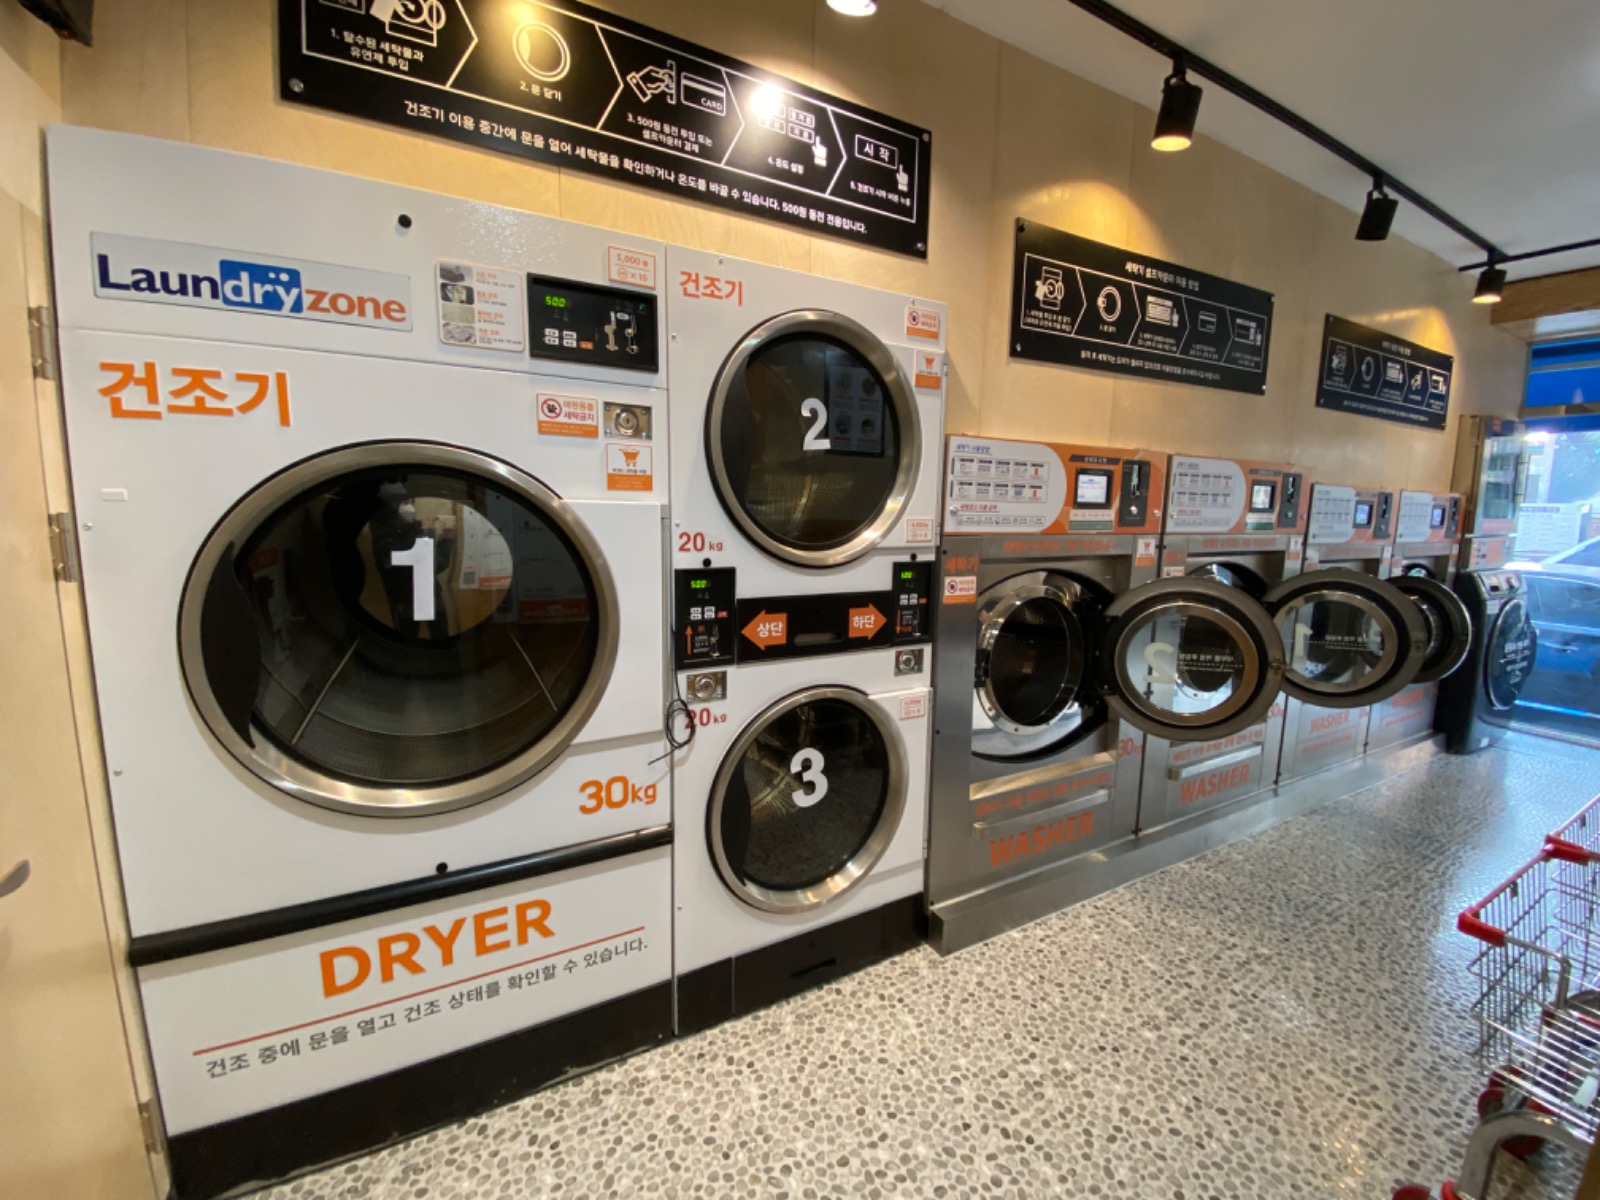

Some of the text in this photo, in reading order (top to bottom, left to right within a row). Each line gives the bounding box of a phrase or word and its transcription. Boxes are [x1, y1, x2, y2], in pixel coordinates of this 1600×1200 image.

[701, 98, 723, 110] CARD
[404, 100, 868, 234] 건조기 이용 중간에 문을 열어 세탁물을 확인하거나 온도를 바꿀 수 있습니다. 500원 동전 전용입니다.
[679, 270, 743, 307] 건조기
[97, 361, 292, 428] 건조기
[801, 397, 831, 452] 2
[391, 536, 436, 621] 1
[757, 620, 784, 638] 상단
[852, 613, 876, 630] 하단
[578, 775, 657, 815] 30kg
[790, 746, 829, 808] 3
[1179, 763, 1250, 806] WASHER
[990, 811, 1095, 868] WASHER
[318, 898, 556, 999] DRYER
[205, 937, 649, 1079] 건조 중에 문을 열고 건조 상태를 확인할 수 있습니다.
